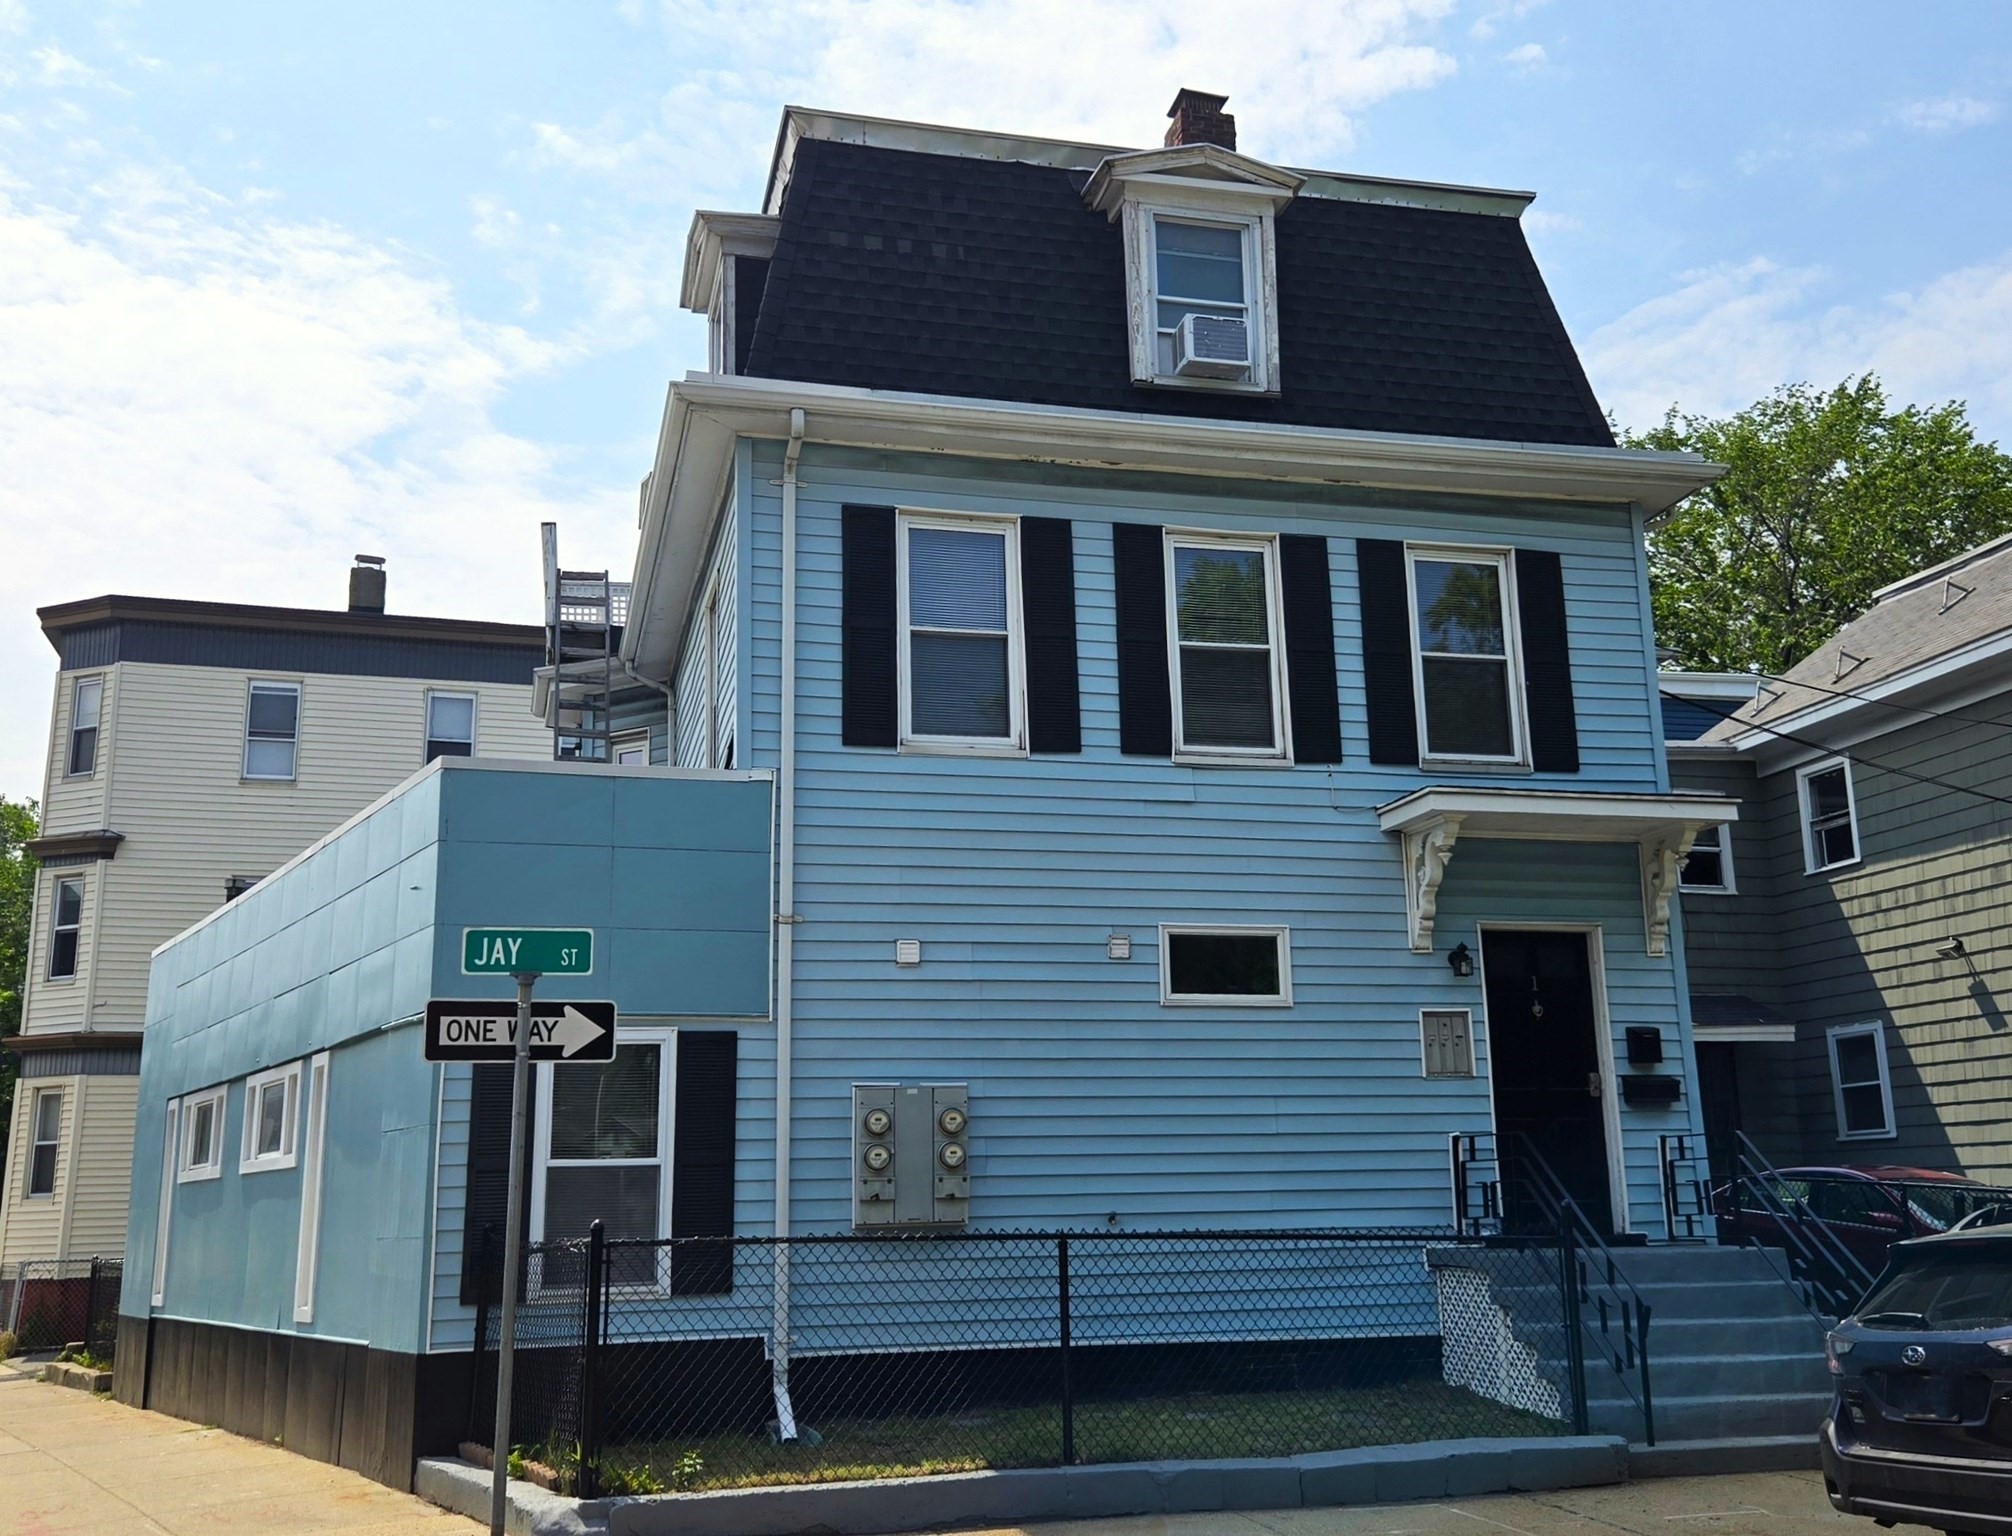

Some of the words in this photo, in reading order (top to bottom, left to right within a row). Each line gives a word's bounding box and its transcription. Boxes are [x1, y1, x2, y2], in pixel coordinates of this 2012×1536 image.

[474, 937, 523, 966] JAY
[561, 949, 578, 966] ST
[446, 1019, 497, 1042] ONE
